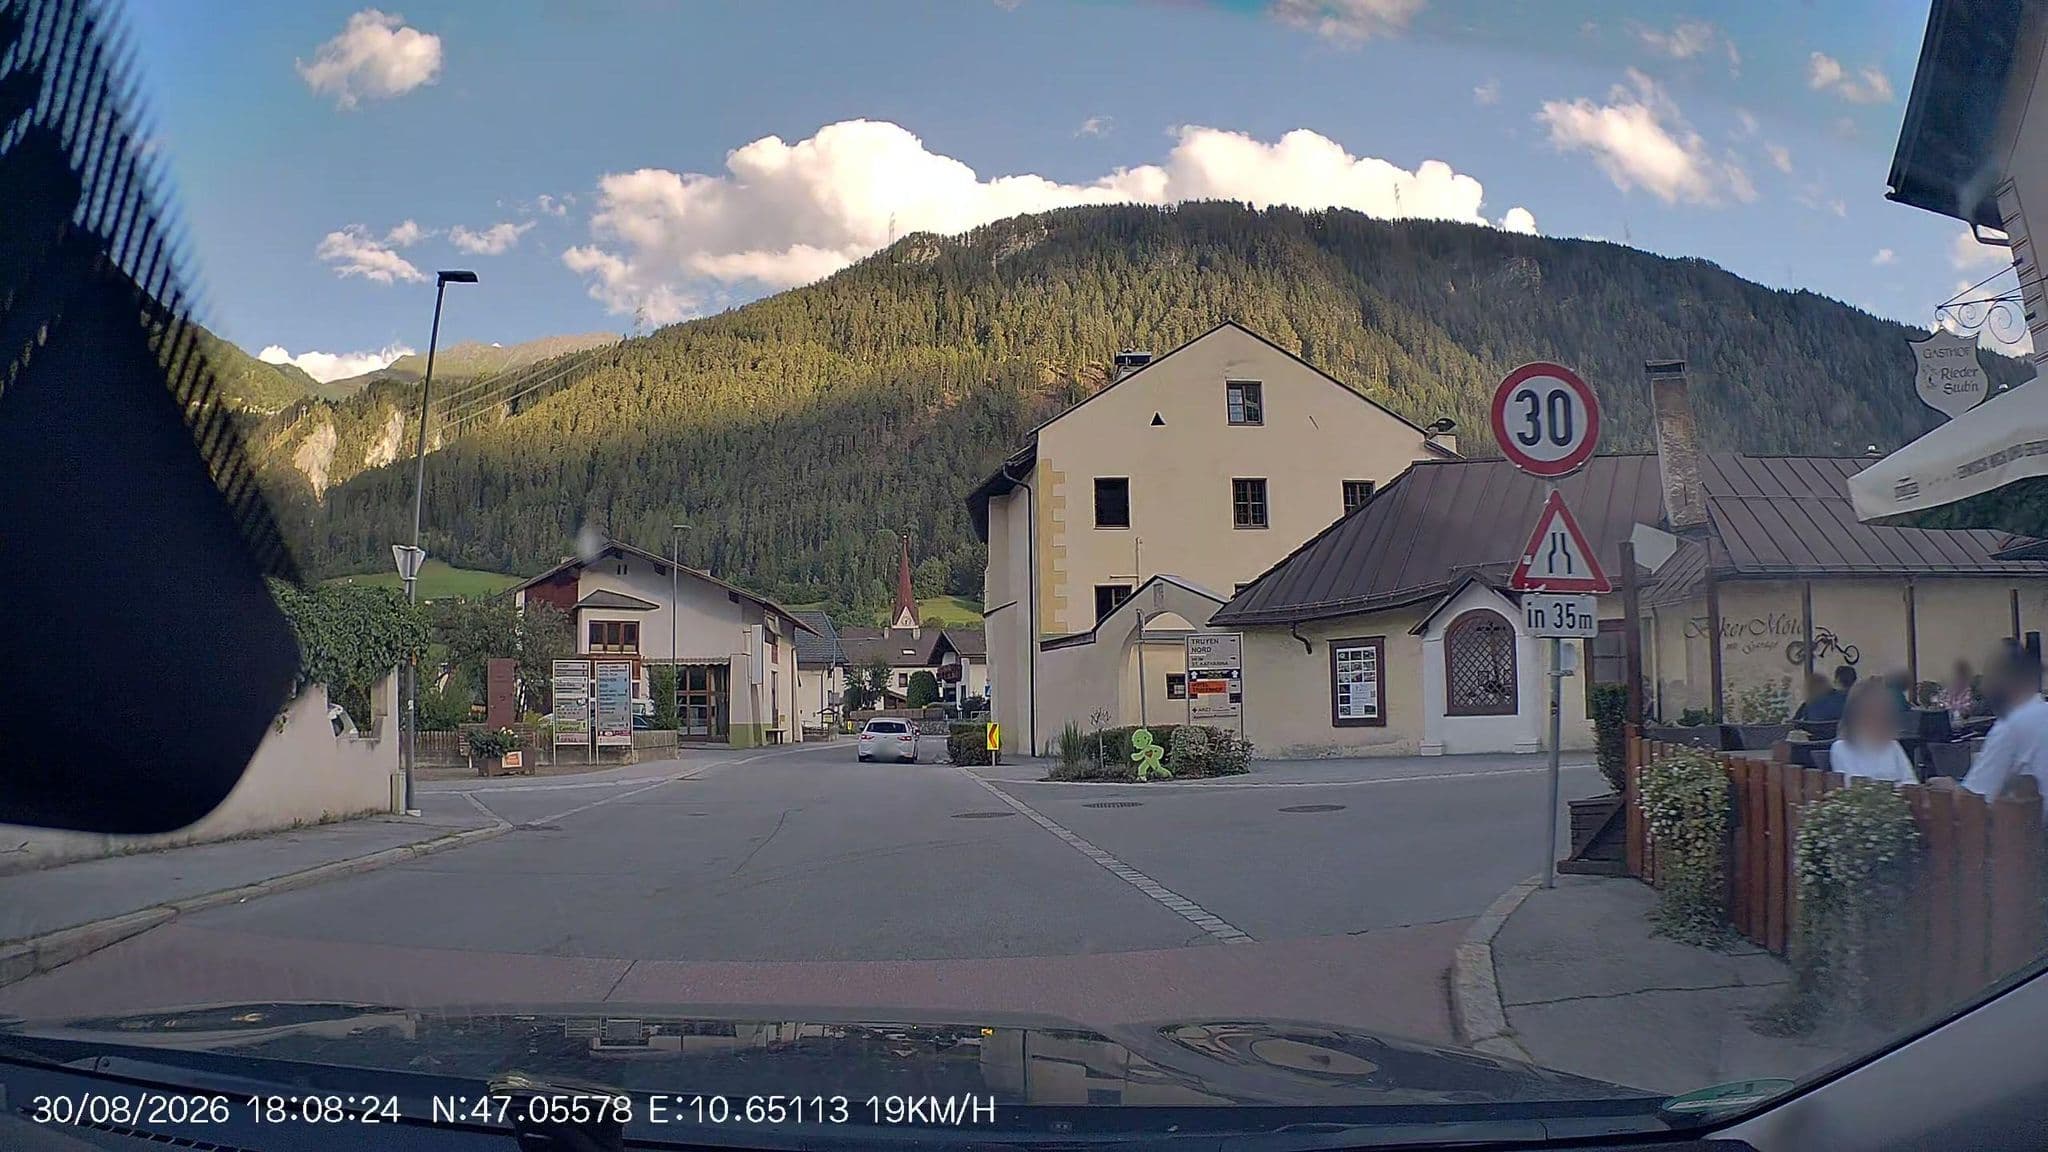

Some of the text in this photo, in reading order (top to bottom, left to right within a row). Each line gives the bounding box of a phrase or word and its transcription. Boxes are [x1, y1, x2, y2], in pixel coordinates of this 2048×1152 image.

[1923, 347, 1971, 359] GASTHOF
[1941, 367, 1979, 381] Rieder
[1515, 389, 1573, 447] 30
[1528, 601, 1545, 629] in
